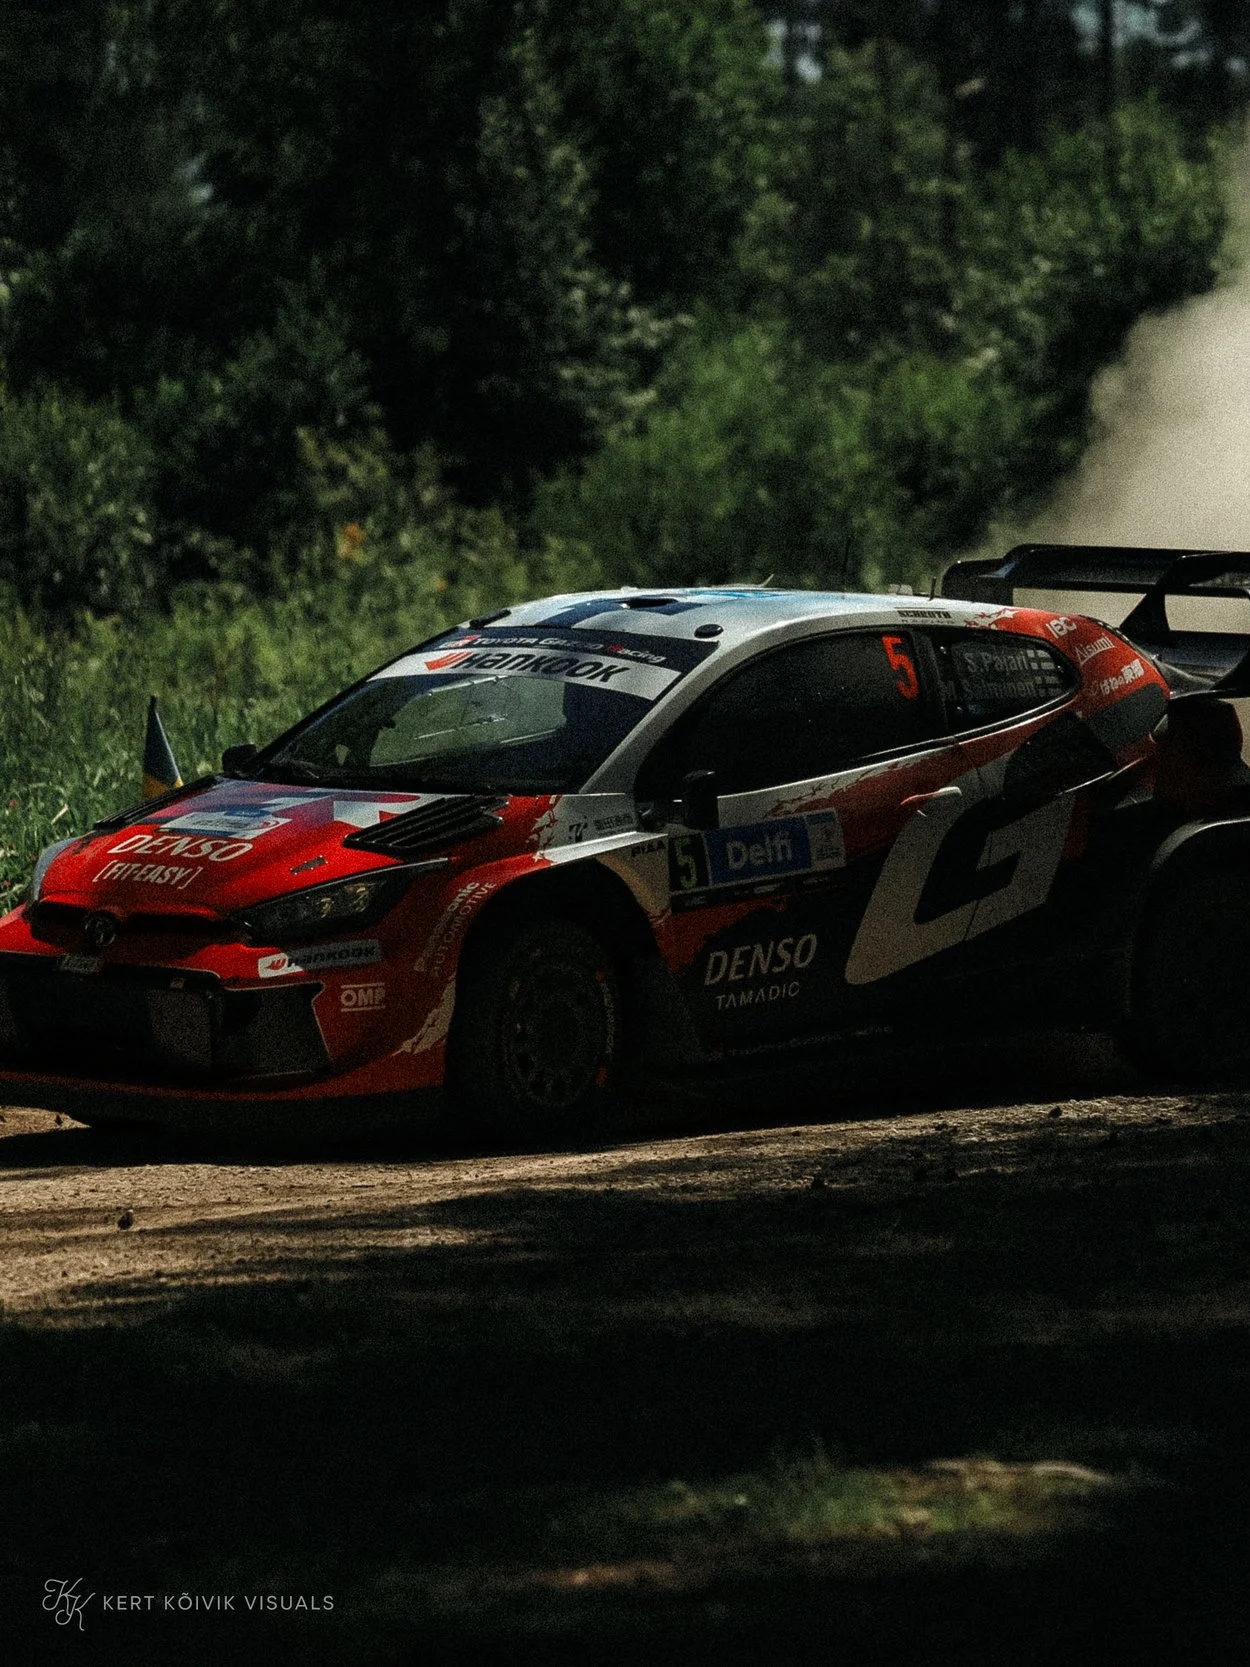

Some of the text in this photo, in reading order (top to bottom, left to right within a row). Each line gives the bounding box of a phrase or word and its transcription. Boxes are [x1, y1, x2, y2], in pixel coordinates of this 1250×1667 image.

[471, 636, 539, 647] TOYOTA
[1046, 617, 1078, 639] IBC
[881, 634, 921, 700] 5
[107, 834, 253, 862] DENSO
[726, 829, 793, 870] Delfi
[674, 838, 699, 890] 5
[704, 933, 818, 986] DENSO
[340, 987, 386, 1007] OMP
[715, 981, 800, 1011] TAMADIC
